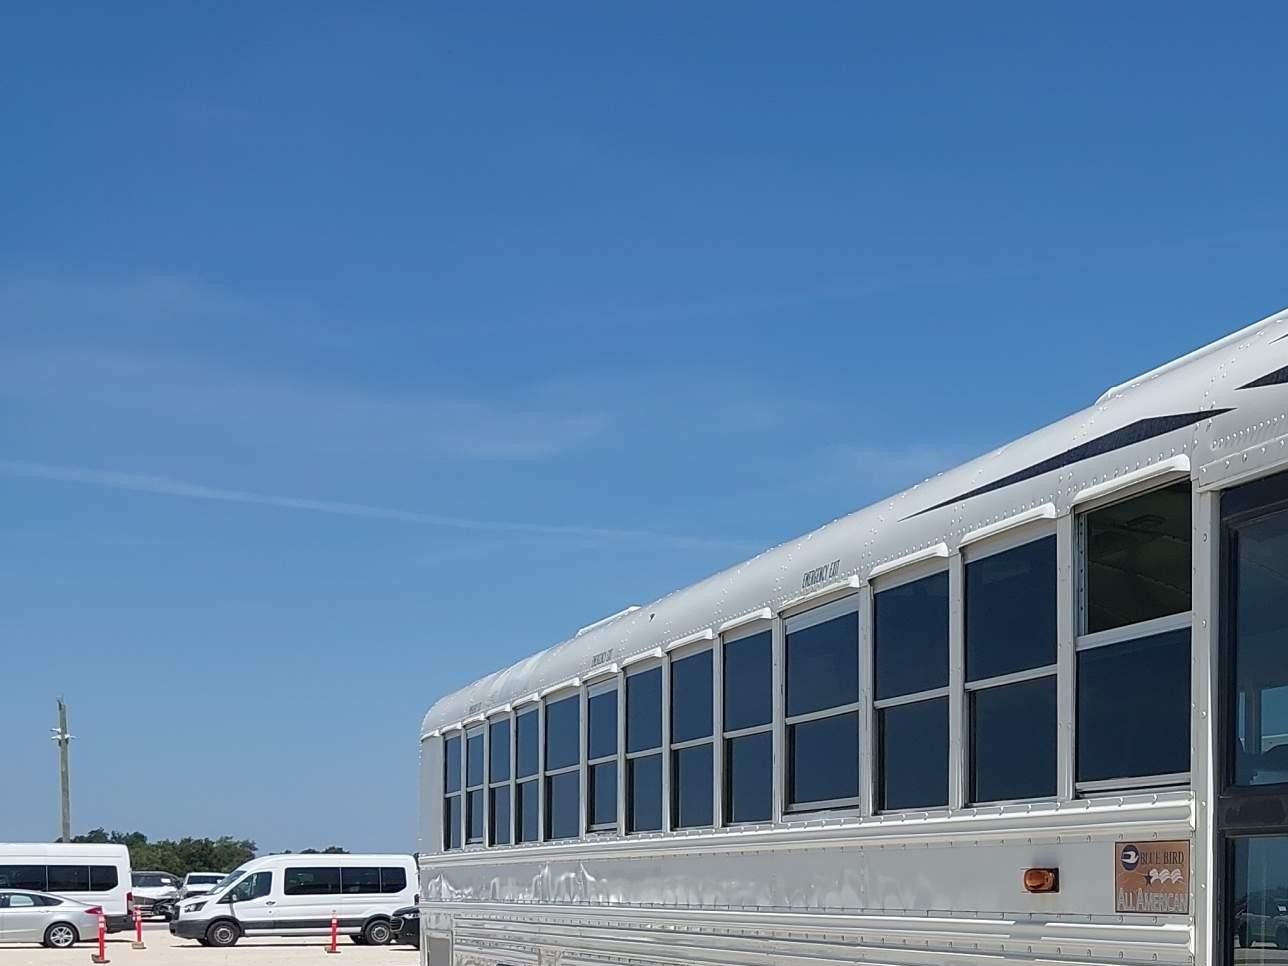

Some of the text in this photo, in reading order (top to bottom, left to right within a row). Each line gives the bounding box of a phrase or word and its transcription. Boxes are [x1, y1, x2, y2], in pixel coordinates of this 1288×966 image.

[801, 559, 841, 588] EMERGENCY EXIT
[1163, 850, 1184, 865] BIRD
